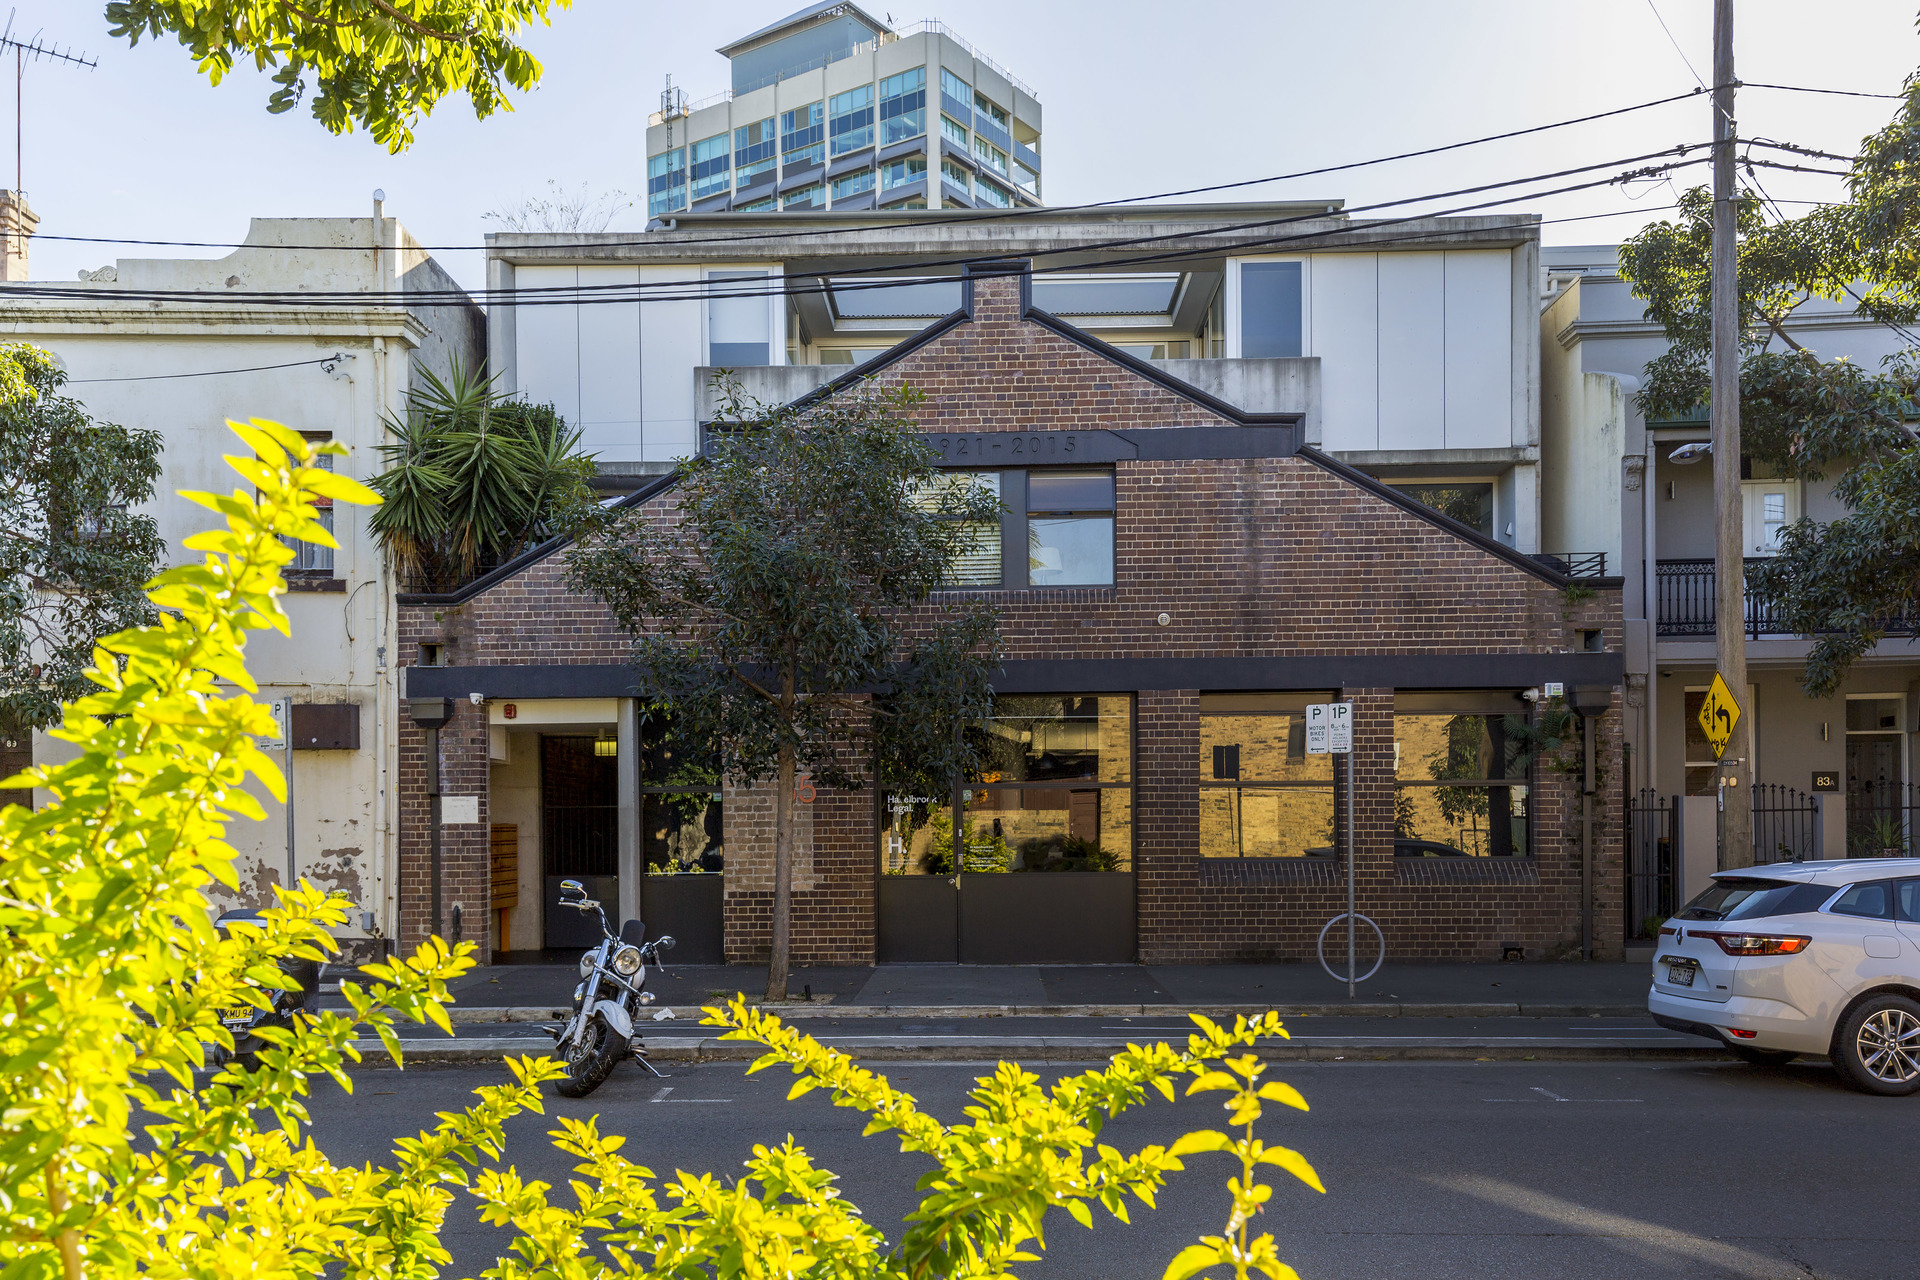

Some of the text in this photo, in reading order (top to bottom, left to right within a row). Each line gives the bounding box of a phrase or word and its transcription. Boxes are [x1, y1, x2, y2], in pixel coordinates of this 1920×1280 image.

[274, 703, 281, 715] P
[1313, 708, 1321, 720] P
[1332, 706, 1347, 718] 1P
[887, 804, 914, 815] Legal.
[888, 836, 908, 854] H.
[223, 1008, 241, 1019] KMU
